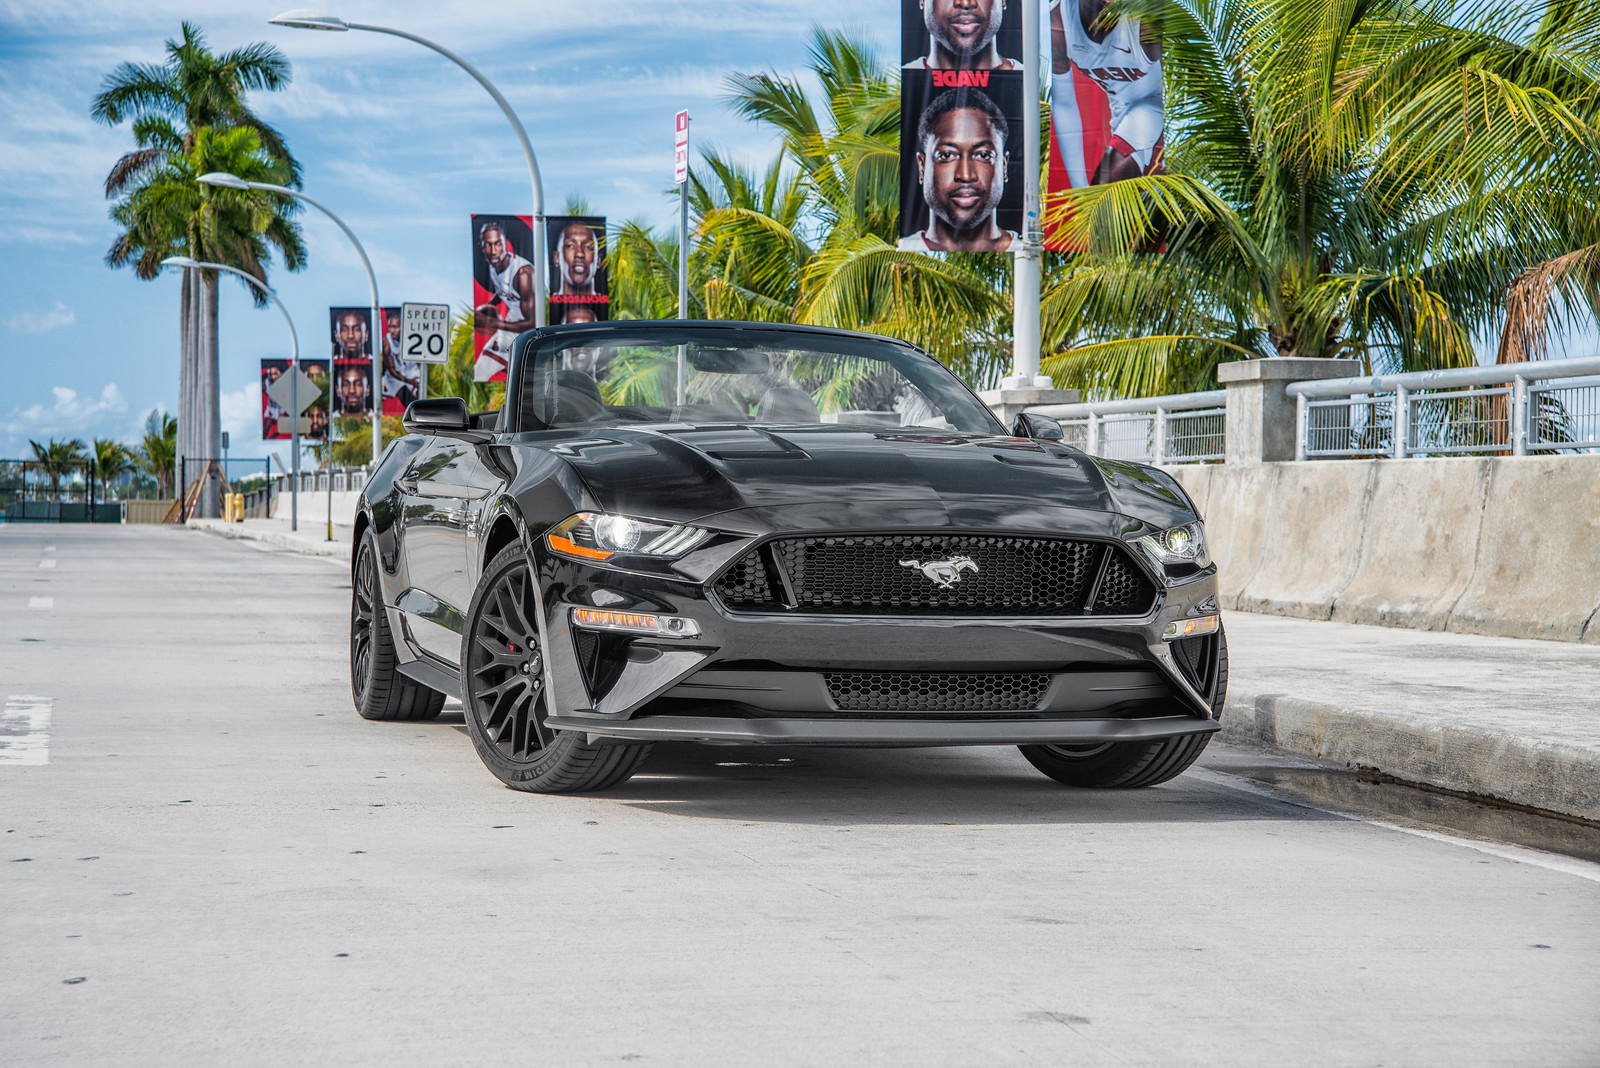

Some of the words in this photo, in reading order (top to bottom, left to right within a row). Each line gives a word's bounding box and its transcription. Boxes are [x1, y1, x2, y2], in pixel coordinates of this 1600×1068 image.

[406, 310, 446, 320] SPEED
[410, 322, 442, 331] LIMIT
[407, 333, 444, 356] 20
[524, 738, 570, 780] MICHELIN
